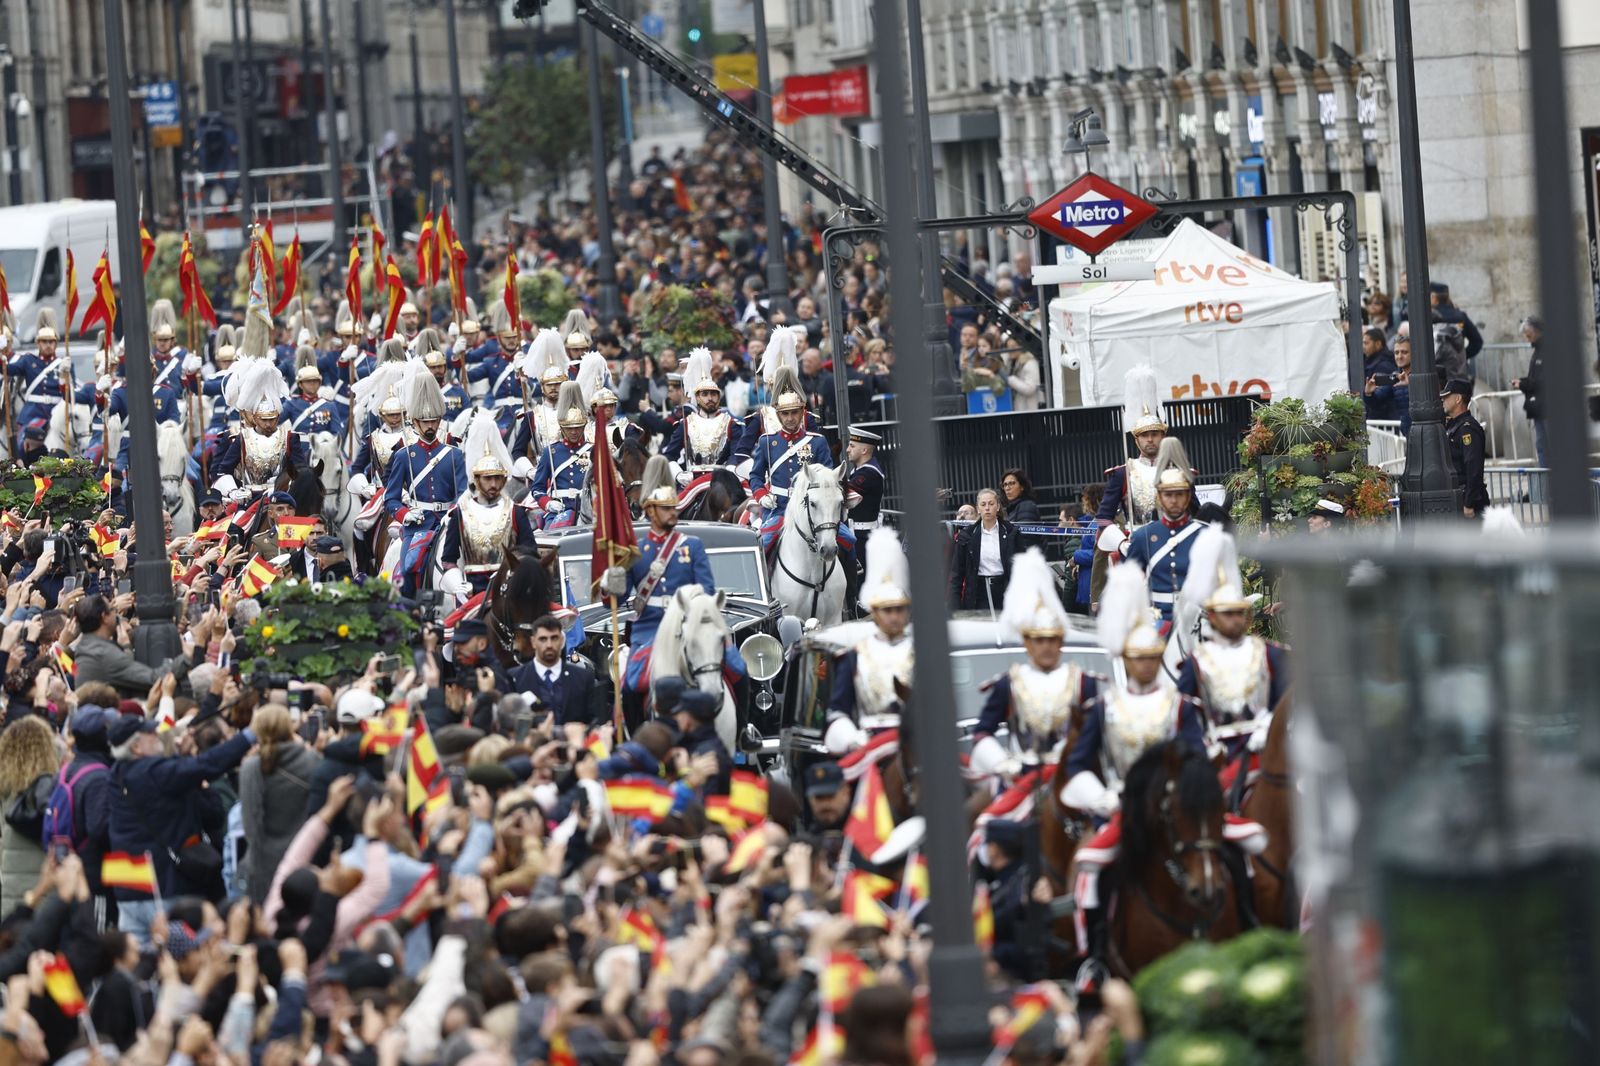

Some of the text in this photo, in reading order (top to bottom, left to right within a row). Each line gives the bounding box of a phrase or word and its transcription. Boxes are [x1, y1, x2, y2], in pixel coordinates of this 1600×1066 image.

[1065, 205, 1120, 223] Metro
[1082, 266, 1107, 279] Sol
[1154, 260, 1249, 287] rtve
[1184, 301, 1244, 324] rtve
